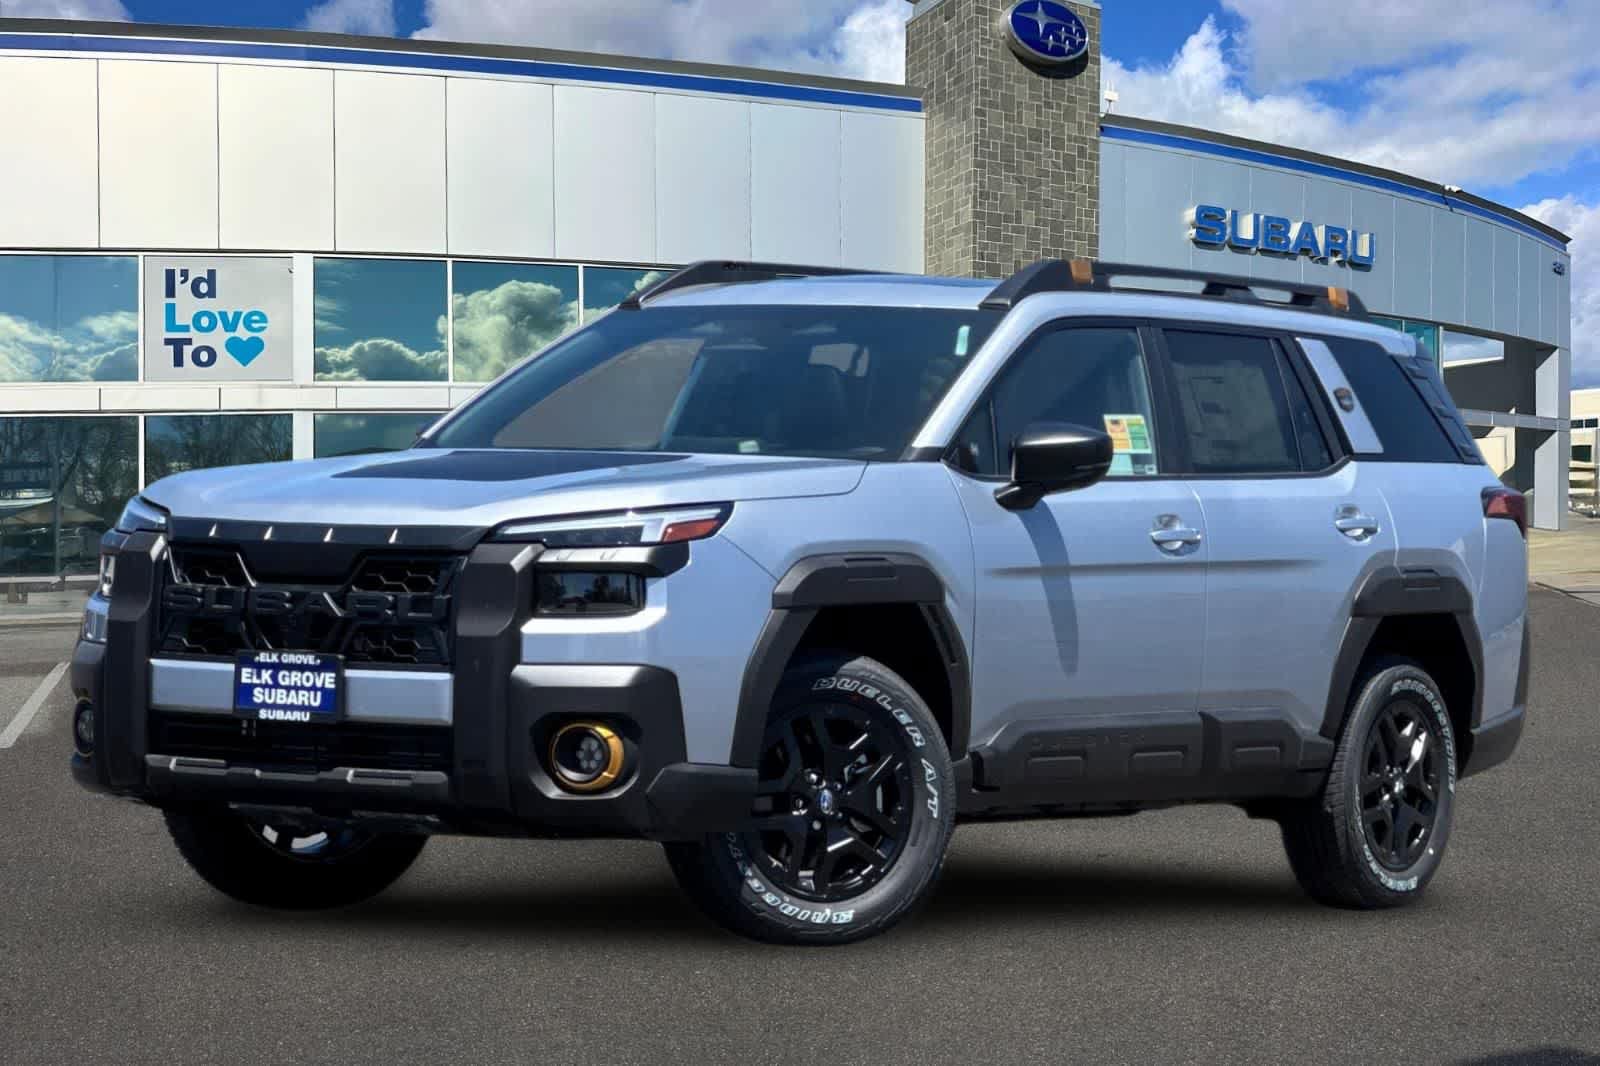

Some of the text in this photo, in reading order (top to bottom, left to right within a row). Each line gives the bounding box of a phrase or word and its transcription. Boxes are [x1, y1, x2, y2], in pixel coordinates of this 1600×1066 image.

[1191, 204, 1376, 270] SUBARU
[165, 303, 268, 333] Love
[164, 338, 217, 368] To
[165, 583, 450, 624] SUBARU
[259, 652, 316, 665] ELK GROVE
[241, 667, 336, 689] ELK GROVE
[252, 687, 321, 707] SUBARU
[259, 708, 310, 722] SUBARU
[812, 677, 938, 819] DUELER A/T
